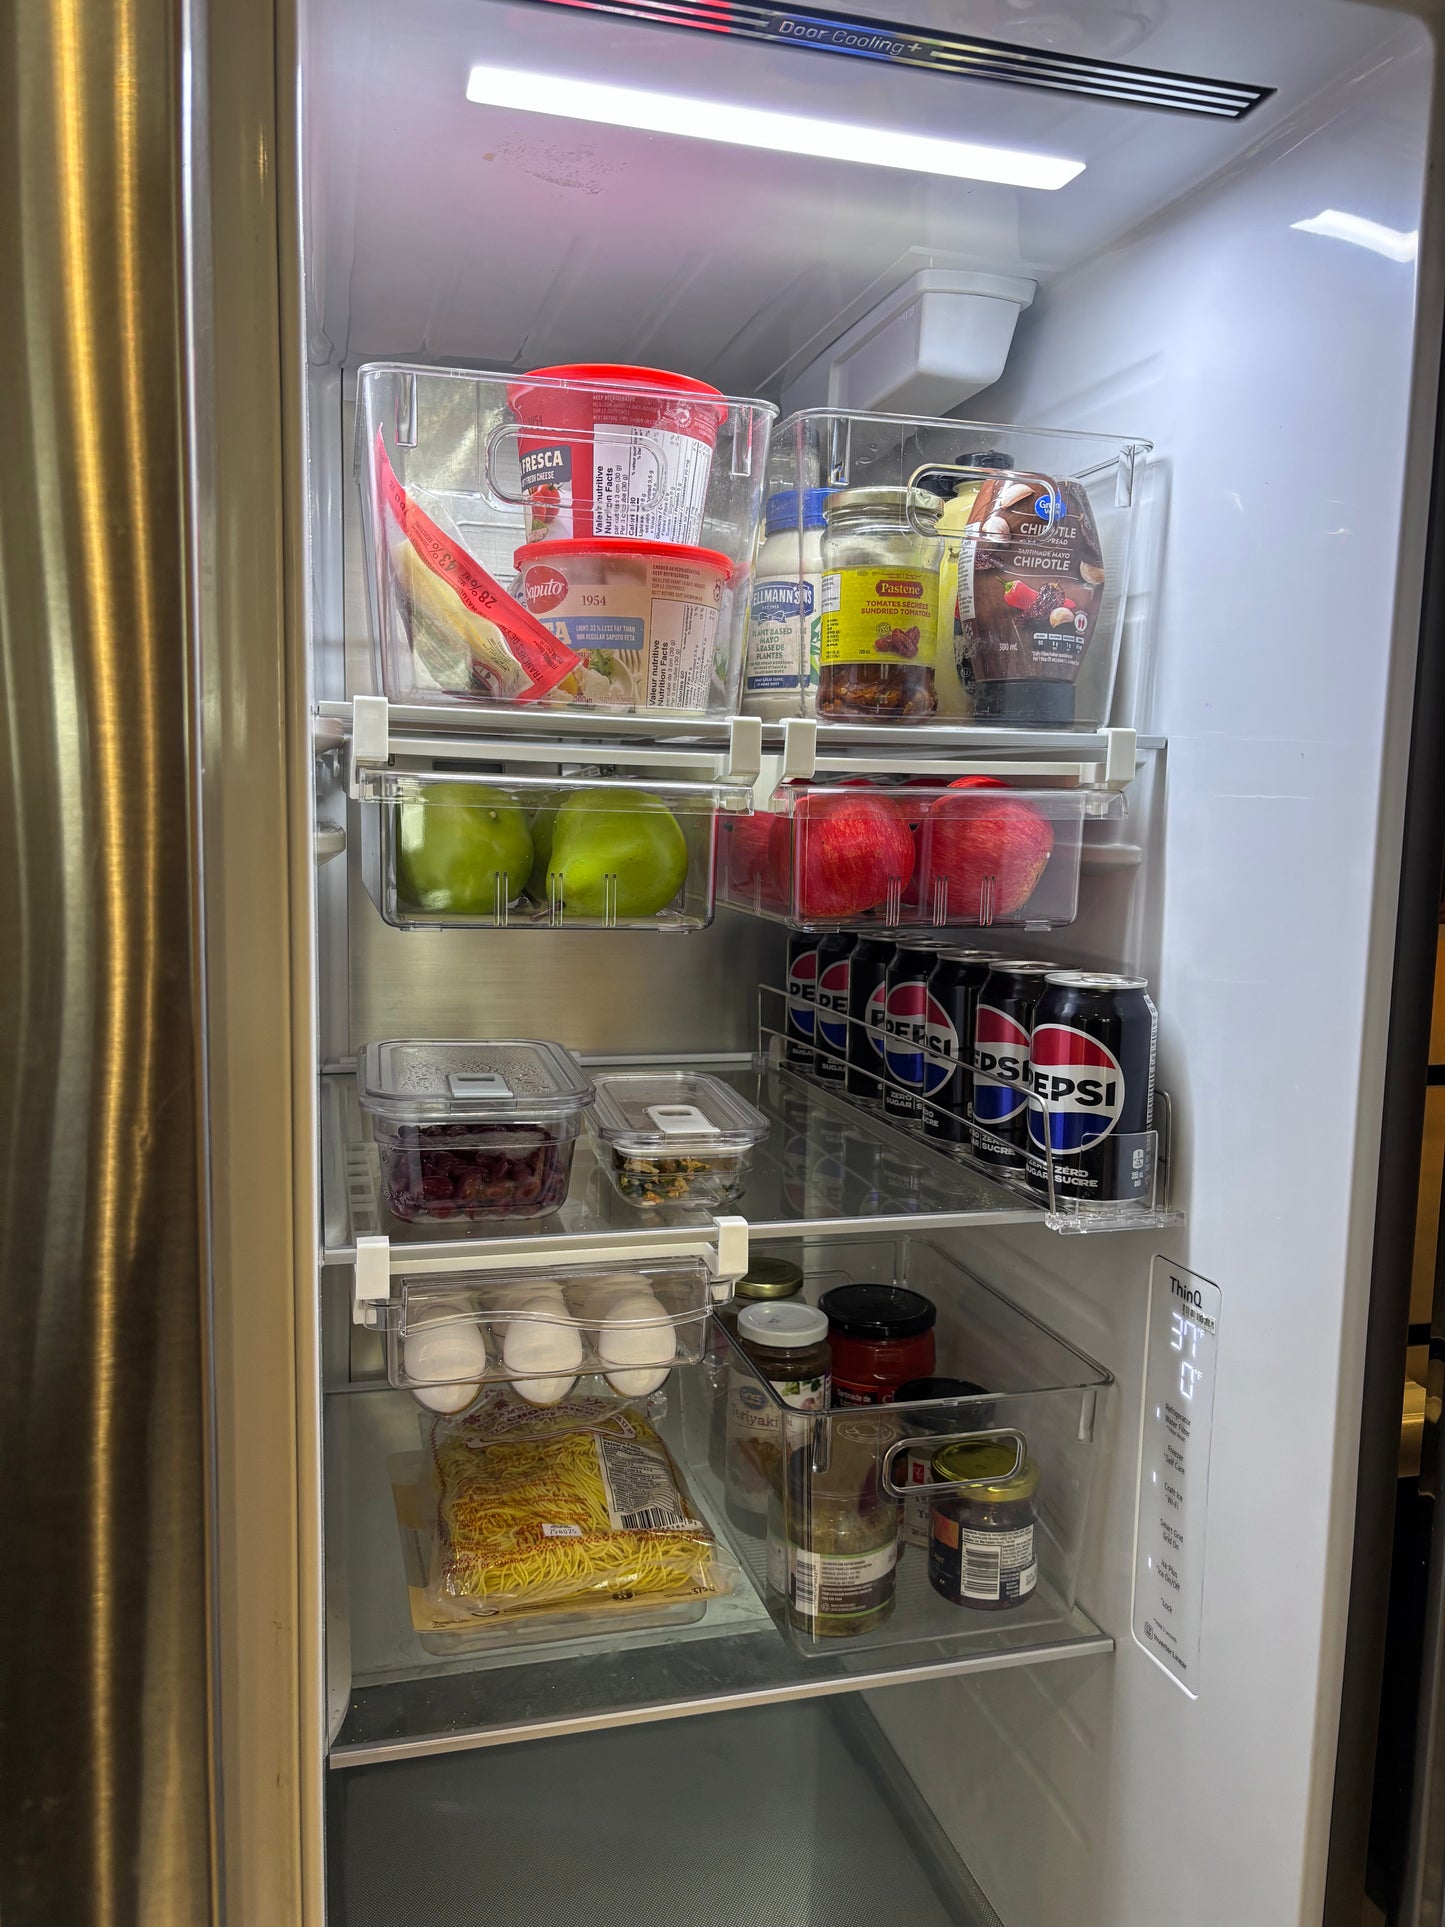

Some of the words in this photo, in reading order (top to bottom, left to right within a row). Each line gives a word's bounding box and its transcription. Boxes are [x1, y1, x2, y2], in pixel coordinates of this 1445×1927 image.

[779, 20, 830, 39] Door
[521, 450, 564, 475] FRESCA
[596, 465, 604, 502] nutritive
[605, 467, 614, 496] Facts
[1020, 522, 1077, 538] CHIPTLE
[1017, 549, 1051, 557] TARTINADE
[1013, 556, 1071, 571] CHIPOTLE
[526, 578, 565, 603] Saputo
[753, 586, 801, 606] ELLMANN'S
[881, 582, 920, 595] Pastene
[582, 595, 607, 606] 1954
[866, 600, 901, 608] TOMATES
[861, 607, 899, 615] SUNDRIED
[901, 609, 931, 618] TOMATOES
[770, 627, 793, 636] BASED
[759, 636, 780, 644] MAYO
[652, 639, 660, 674] nutritive
[660, 642, 668, 666] Facts
[756, 652, 783, 660] PLANTES
[516, 644, 544, 682] TRANCHES
[649, 676, 658, 706] Valeur
[657, 669, 667, 707] Nutrition
[886, 1097, 913, 1109] SUGAR
[890, 1090, 913, 1101] ZERO
[981, 1143, 1016, 1156] SUCRE
[1054, 1163, 1089, 1178] ZÉRO
[1054, 1174, 1099, 1188] SUCRE
[1169, 1275, 1203, 1309] ThinQ
[1170, 1311, 1197, 1358] 37
[1165, 1402, 1191, 1426] Refrigerator
[1165, 1414, 1178, 1428] Water
[1178, 1423, 1191, 1438] Filter
[1167, 1444, 1184, 1462] Freezer
[1174, 1462, 1185, 1475] Care
[1164, 1481, 1176, 1497] Craft
[1160, 1517, 1173, 1535] Smart
[1173, 1529, 1184, 1543] Grid
[1162, 1532, 1172, 1545] Grid
[1172, 1540, 1179, 1551] On
[494, 1557, 524, 1568] CANADA
[1168, 1564, 1178, 1579] Plus
